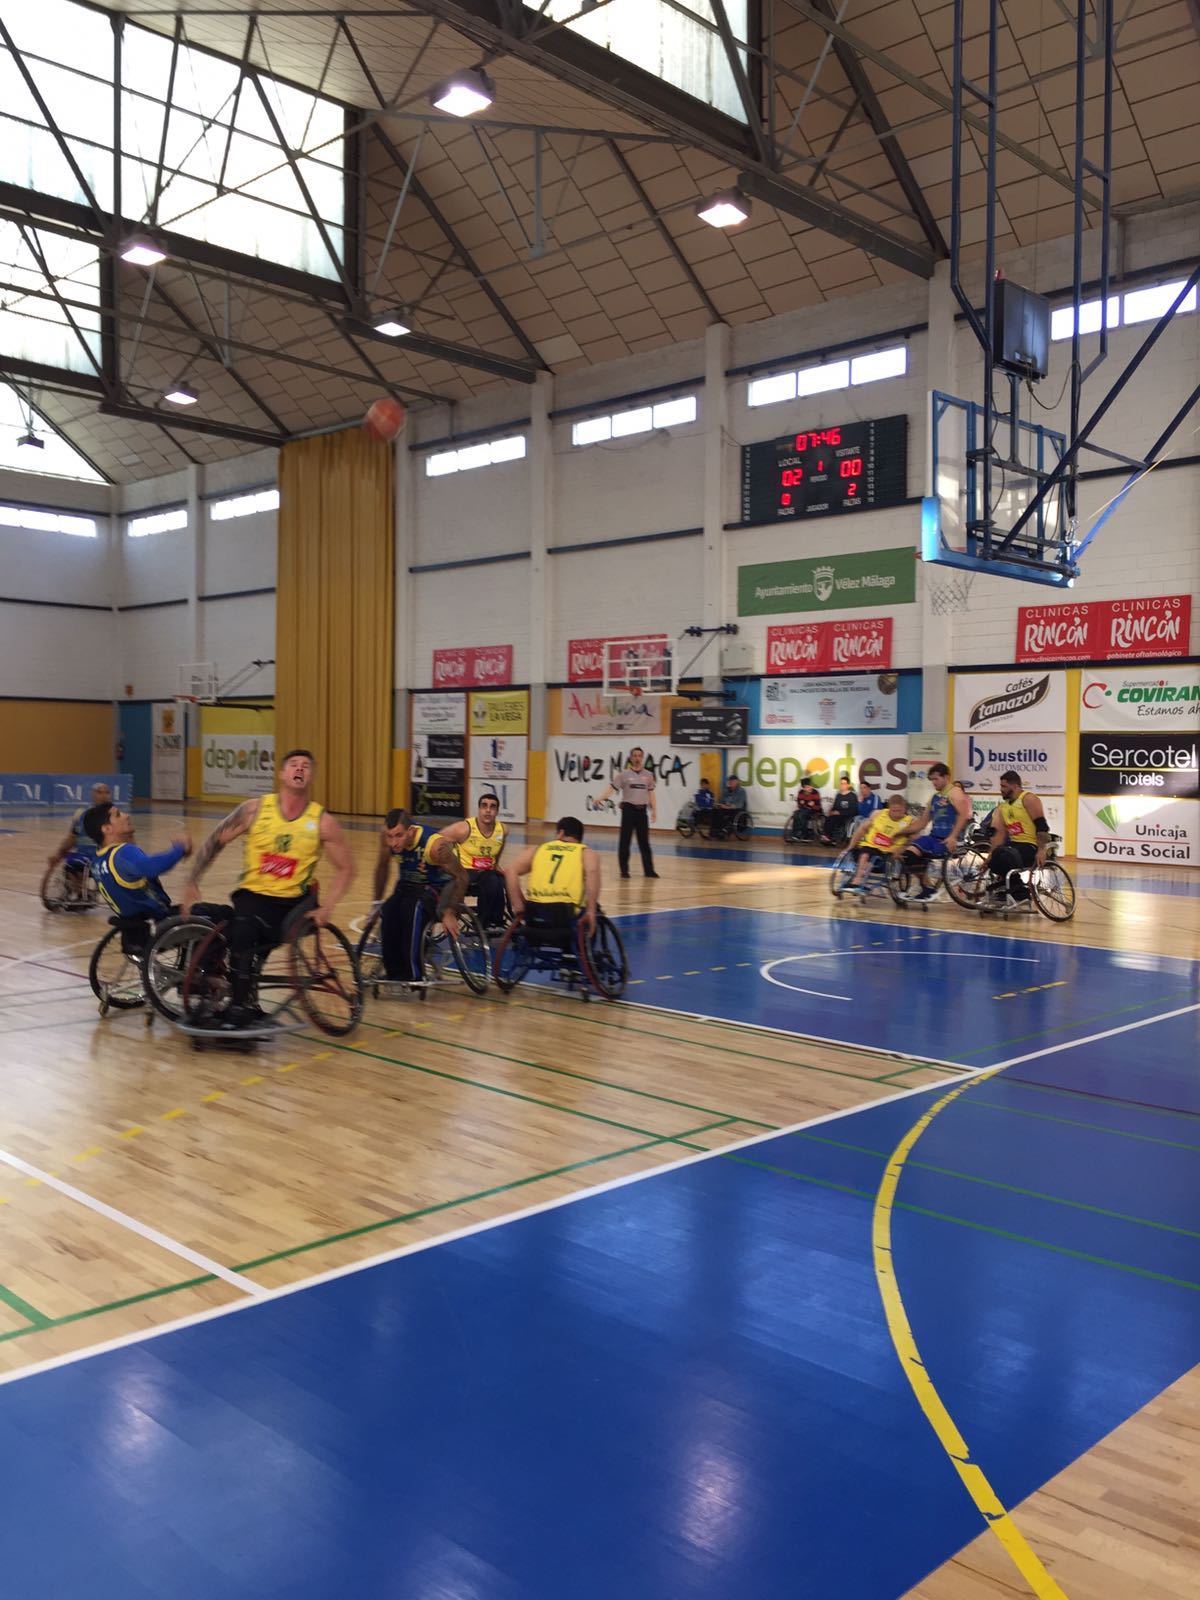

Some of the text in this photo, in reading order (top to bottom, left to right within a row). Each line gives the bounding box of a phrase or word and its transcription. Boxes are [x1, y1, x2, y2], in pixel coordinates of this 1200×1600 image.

[796, 428, 841, 451] 07:46
[778, 457, 802, 467] LOCAL
[817, 460, 824, 472] 1
[840, 458, 862, 478] 00
[781, 468, 802, 487] 02
[848, 483, 856, 496] 2
[755, 574, 896, 600] Ayuntamiento Vélez Málaga
[1025, 604, 1090, 619] CLINICAS
[1112, 598, 1182, 612] CLINICAS
[771, 624, 819, 637] CLINICAS
[833, 620, 884, 632] CLINICAS
[1106, 652, 1135, 660] gabinete
[1006, 678, 1034, 692] Cafés
[978, 686, 1040, 720] tamazor
[1137, 704, 1184, 716] Estamos
[988, 749, 1048, 762] bustillo
[1091, 742, 1197, 768] Sercotel
[733, 743, 910, 802] deportes
[1120, 772, 1165, 787] hotels
[1135, 824, 1188, 840] Unicaja
[1094, 841, 1190, 860] Obra Social
[549, 854, 564, 884] 7
